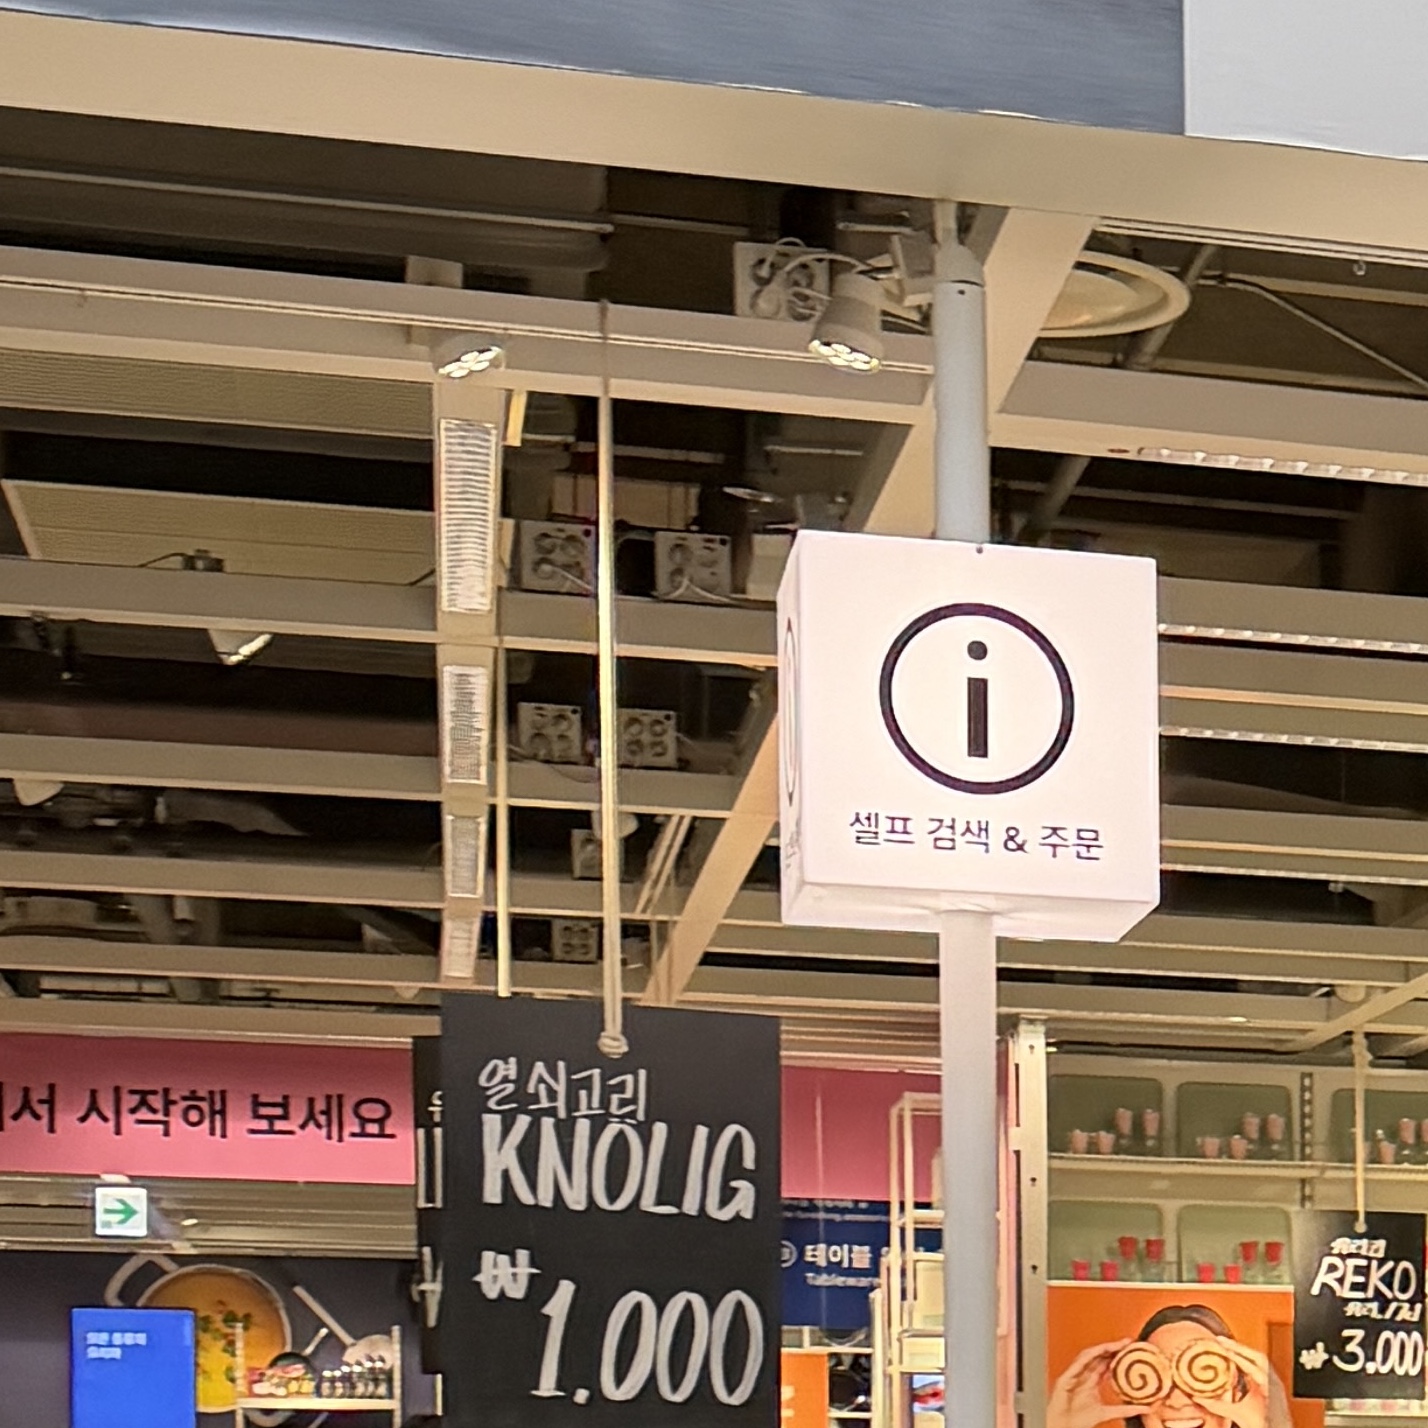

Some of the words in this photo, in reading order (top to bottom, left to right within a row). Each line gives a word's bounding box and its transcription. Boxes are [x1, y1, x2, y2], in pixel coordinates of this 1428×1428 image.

[849, 811, 915, 846] 셀프
[926, 817, 990, 853] 검색
[1003, 826, 1029, 853] &
[1039, 825, 1104, 861] 주문
[0, 1081, 56, 1135] 서
[77, 1085, 229, 1140] 시작해
[246, 1092, 398, 1143] 보세요
[478, 1056, 647, 1121] 열쇠고리
[1309, 1255, 1417, 1301] REKO
